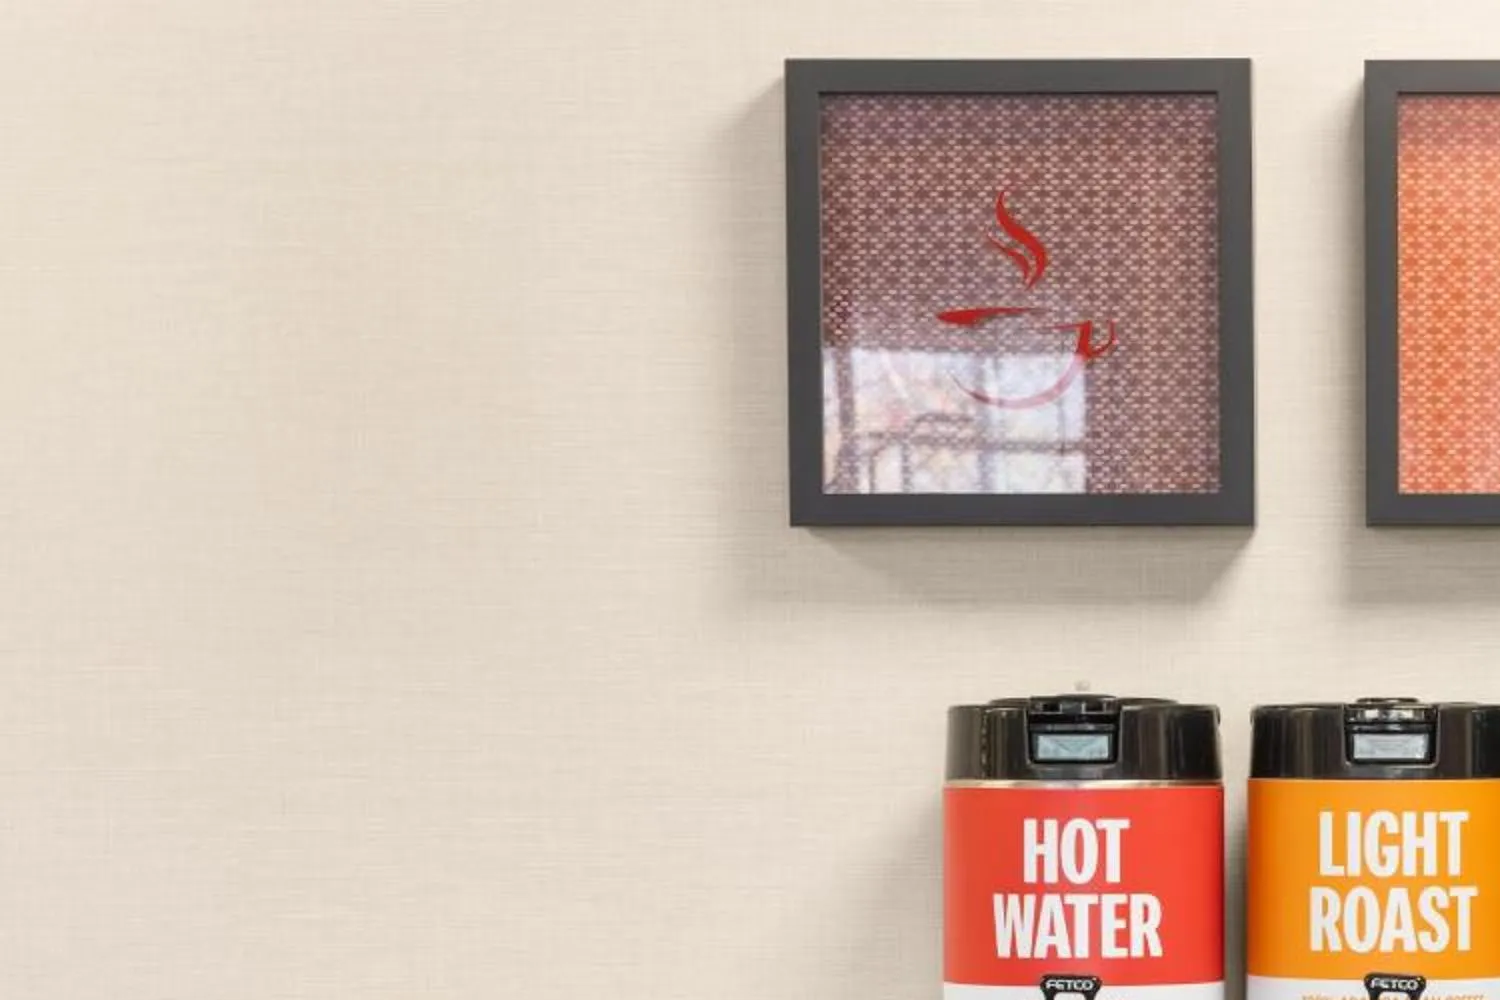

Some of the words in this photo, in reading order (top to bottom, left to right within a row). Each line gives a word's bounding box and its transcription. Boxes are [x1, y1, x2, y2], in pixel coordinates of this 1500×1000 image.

[1023, 818, 1130, 884] HOT
[1319, 810, 1469, 877] LIGHT
[993, 893, 1163, 959] WATER
[1310, 886, 1478, 953] ROAST
[1045, 979, 1095, 991] FETCO
[1371, 977, 1419, 991] FETCO
